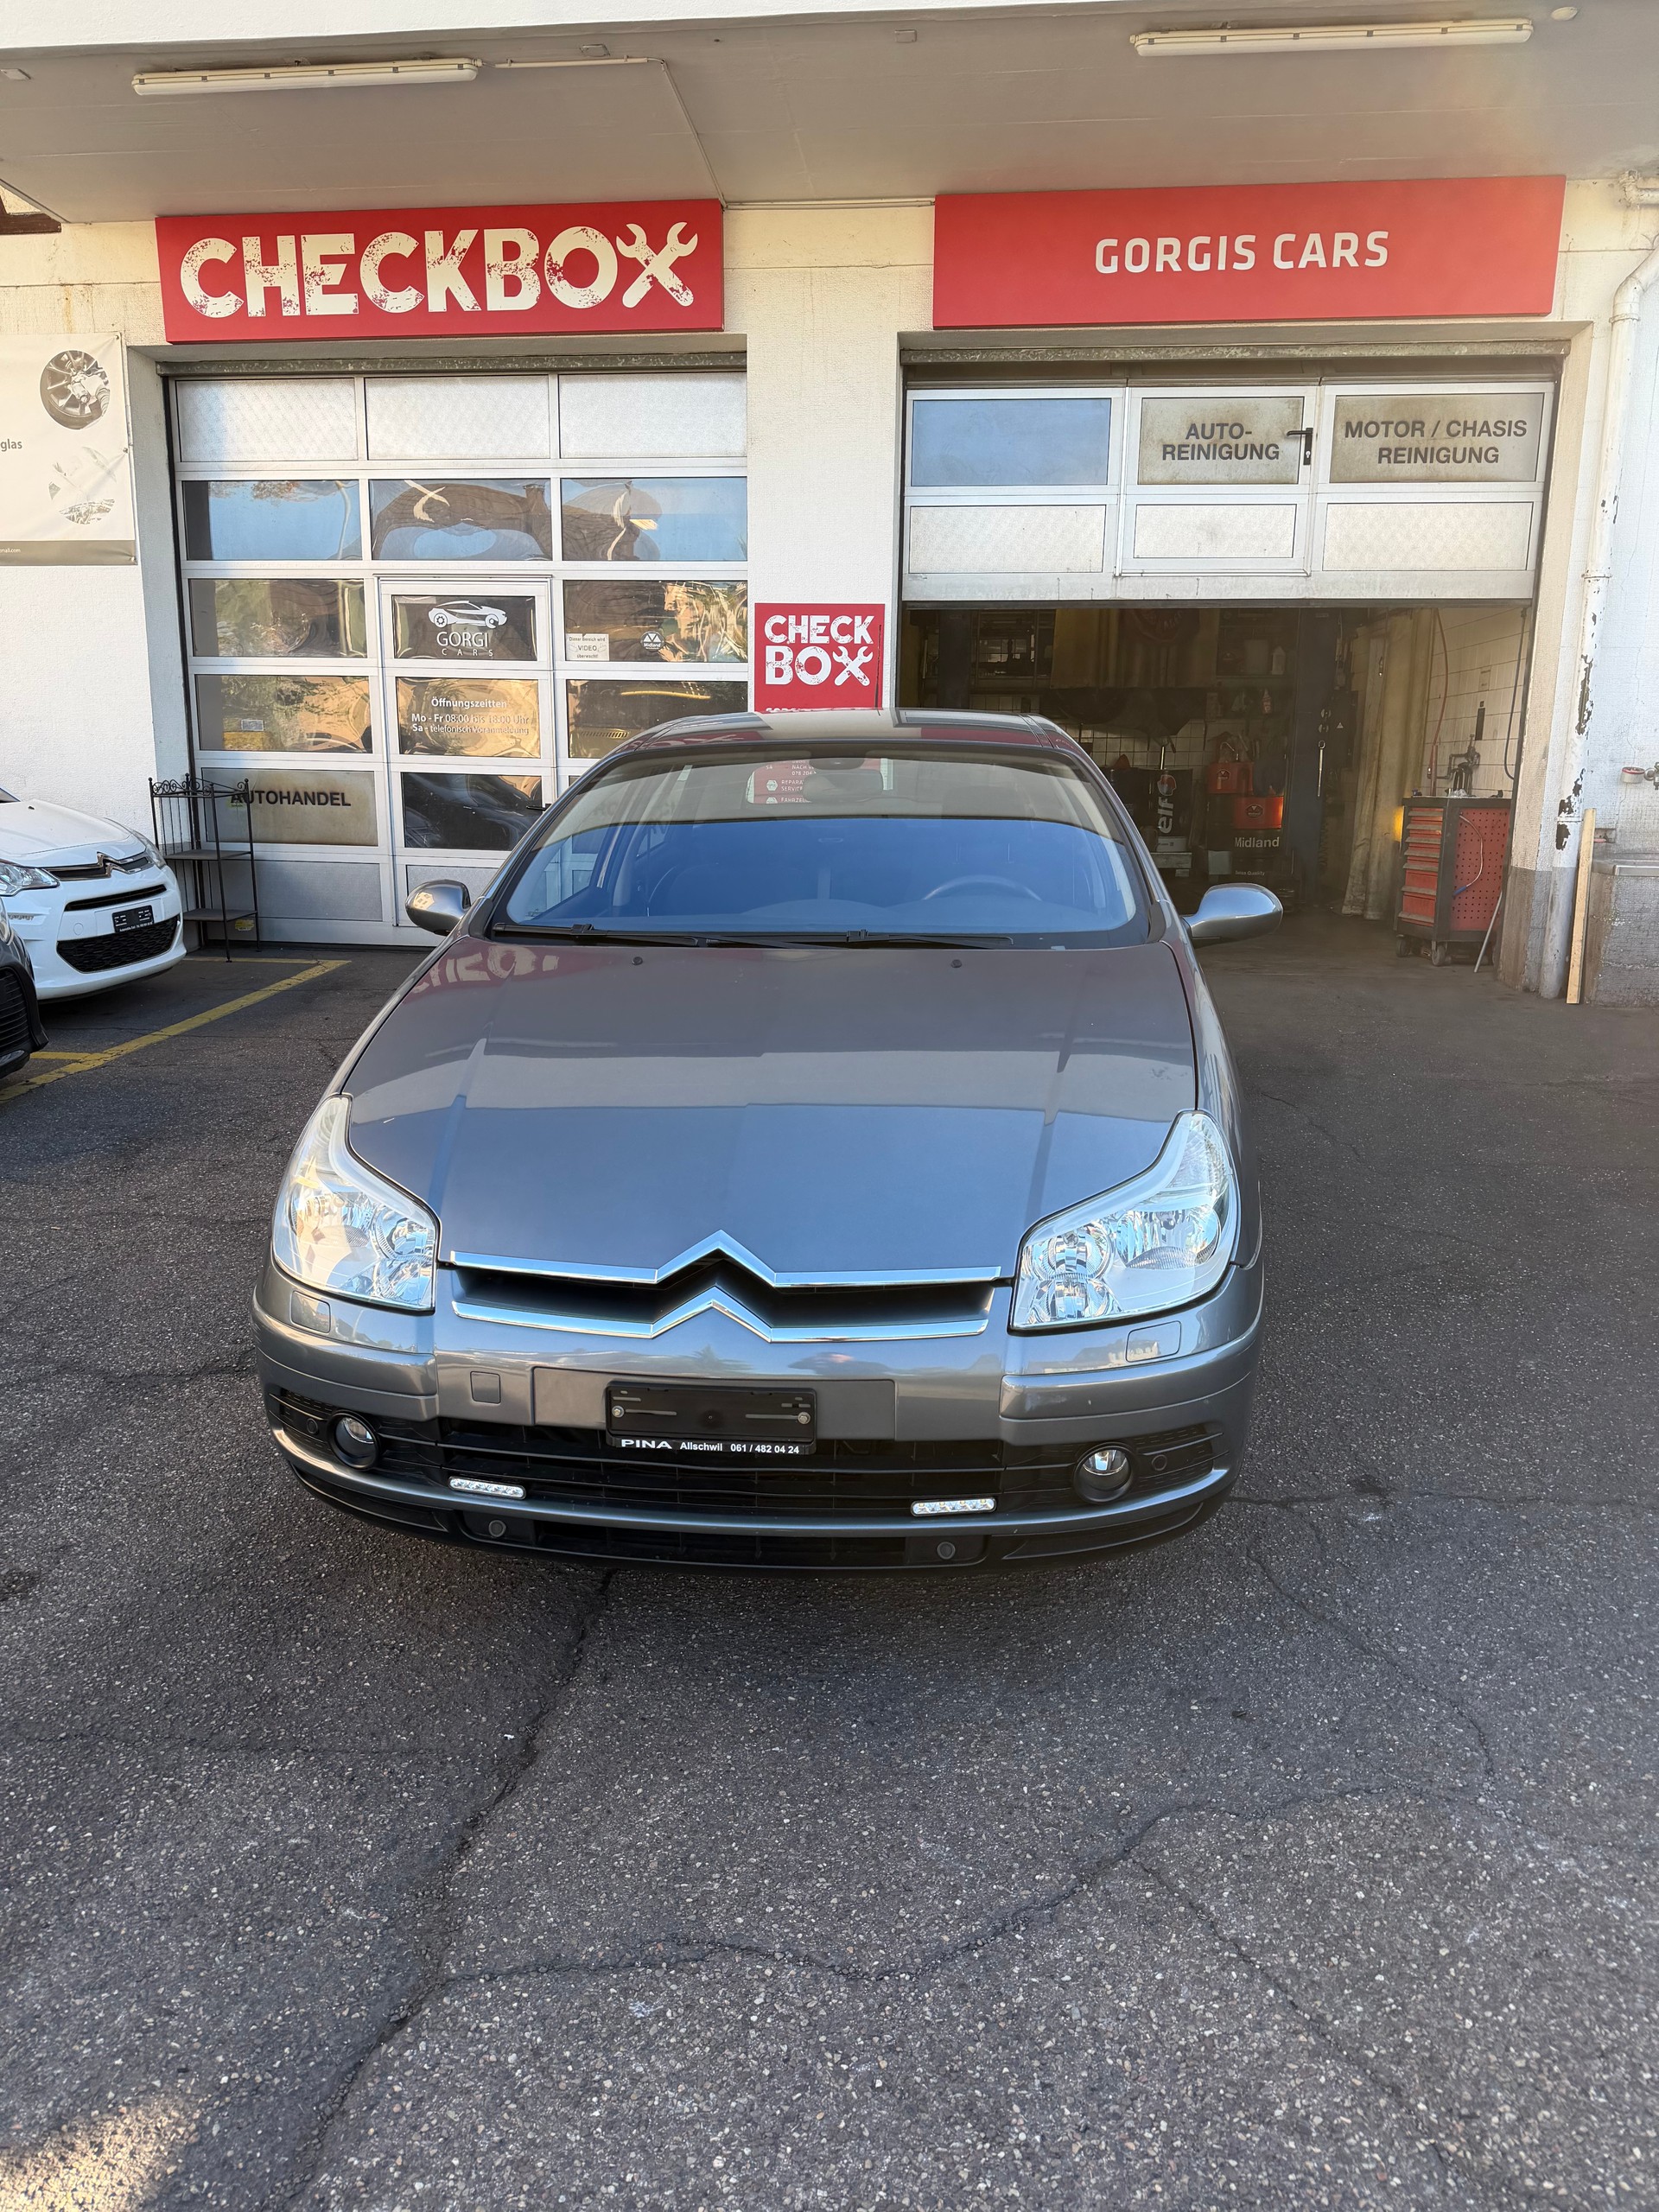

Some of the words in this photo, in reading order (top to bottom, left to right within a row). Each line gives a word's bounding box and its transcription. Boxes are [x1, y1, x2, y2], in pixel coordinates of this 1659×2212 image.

[1095, 234, 1255, 275] GORGIS
[1273, 231, 1389, 270] CARS
[180, 221, 698, 319] CHECKBOX
[1185, 423, 1253, 441] AUTO-
[1344, 421, 1427, 439] MOTOR
[1446, 419, 1528, 438] CHASIS
[1161, 442, 1281, 461] REINIGUNG
[1377, 446, 1500, 465] REINIGUNG
[764, 614, 875, 645] CHECK
[436, 632, 488, 648] GORGI
[765, 645, 874, 686] BOX
[431, 697, 507, 709] Öffnungszeitten
[411, 714, 427, 722] Mo
[445, 715, 469, 723] 08:00
[471, 715, 486, 723] bis
[513, 715, 529, 724] Uhr
[1235, 836, 1280, 848] Midland
[621, 1439, 672, 1450] PINA
[680, 1442, 723, 1452] Allschwil
[730, 1444, 747, 1452] 061
[754, 1445, 772, 1453] 482
[787, 1446, 800, 1454] 24
